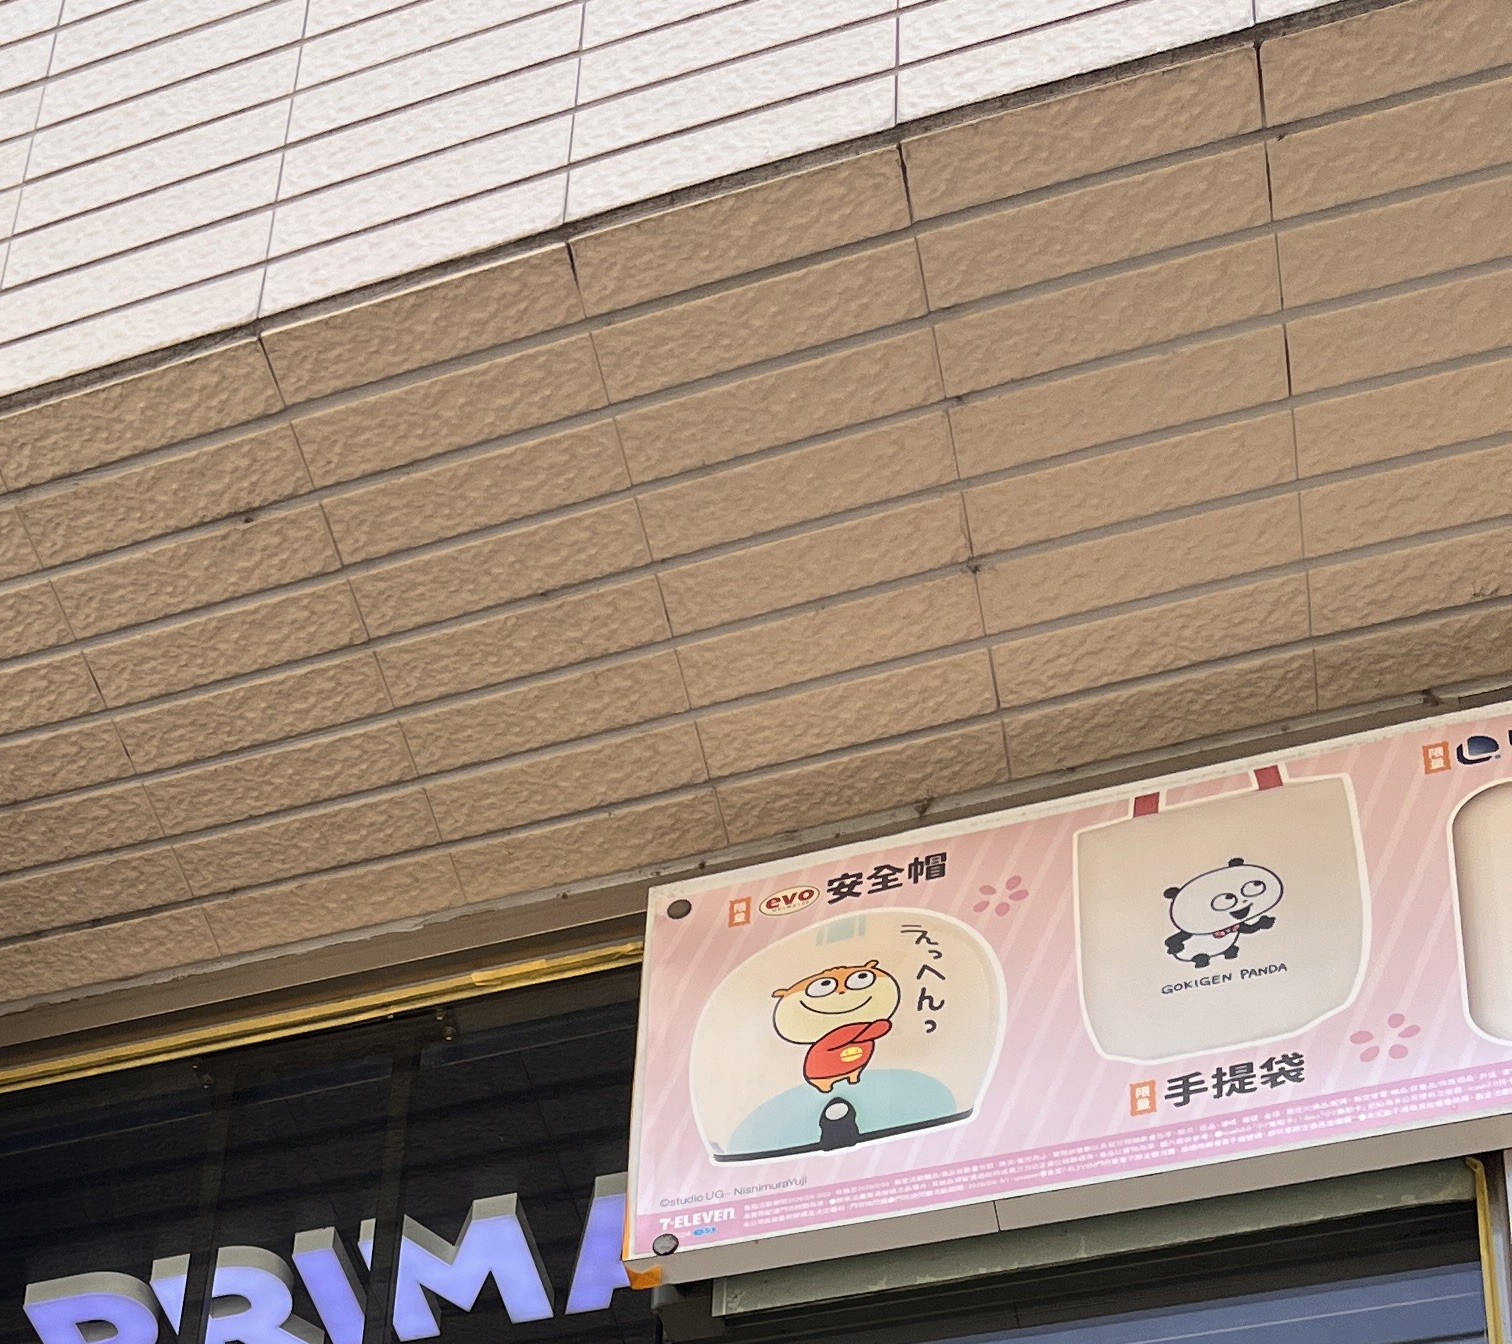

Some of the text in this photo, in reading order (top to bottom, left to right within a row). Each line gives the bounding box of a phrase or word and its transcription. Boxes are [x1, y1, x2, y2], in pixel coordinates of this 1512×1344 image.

[765, 889, 815, 910] evo
[826, 852, 947, 904] 安全帽
[900, 924, 946, 1033] えっへんっ
[1161, 963, 1288, 995] GOKIGEN PANDA
[1164, 1052, 1305, 1108] 手提袋
